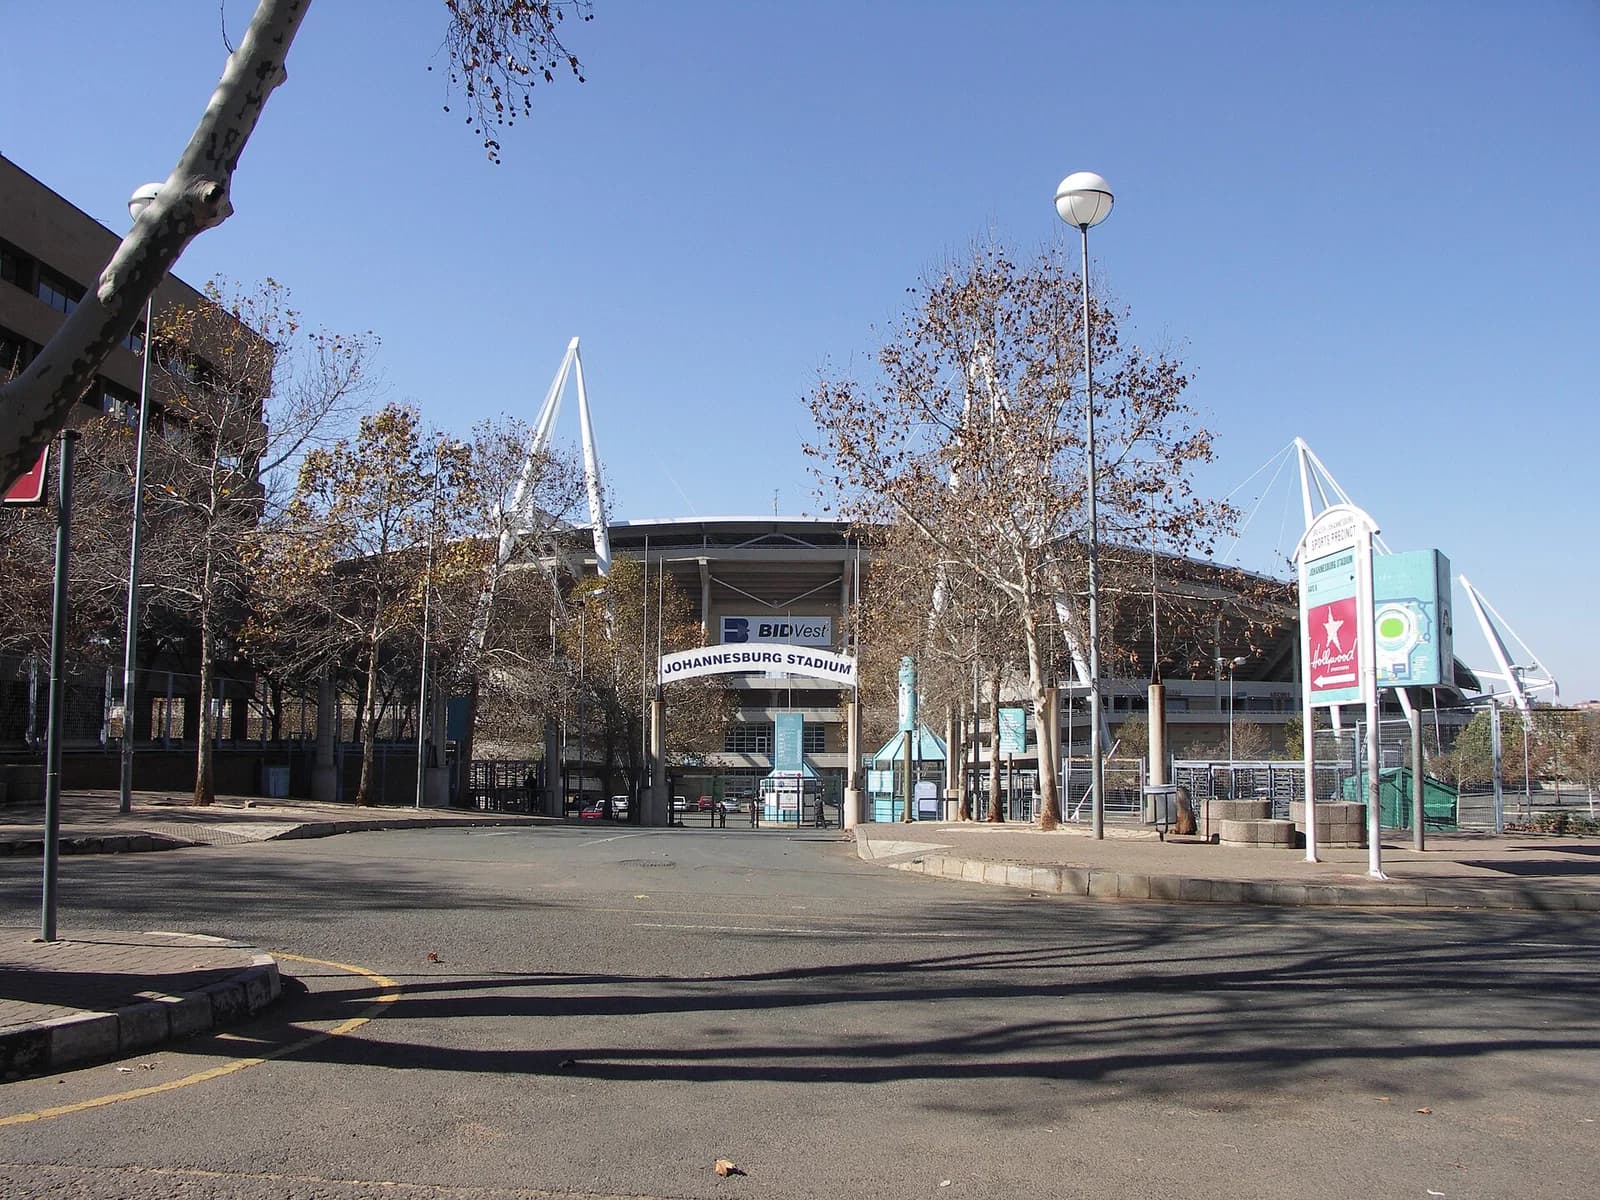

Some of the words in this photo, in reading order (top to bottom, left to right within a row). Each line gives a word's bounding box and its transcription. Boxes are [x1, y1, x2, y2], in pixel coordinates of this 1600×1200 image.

[1311, 533, 1330, 551] SPORTS
[1331, 524, 1356, 543] PRECINCT
[663, 652, 782, 675] JOHANNESBURG
[787, 654, 853, 676] STADIUM
[1310, 638, 1358, 674] Hollywood
